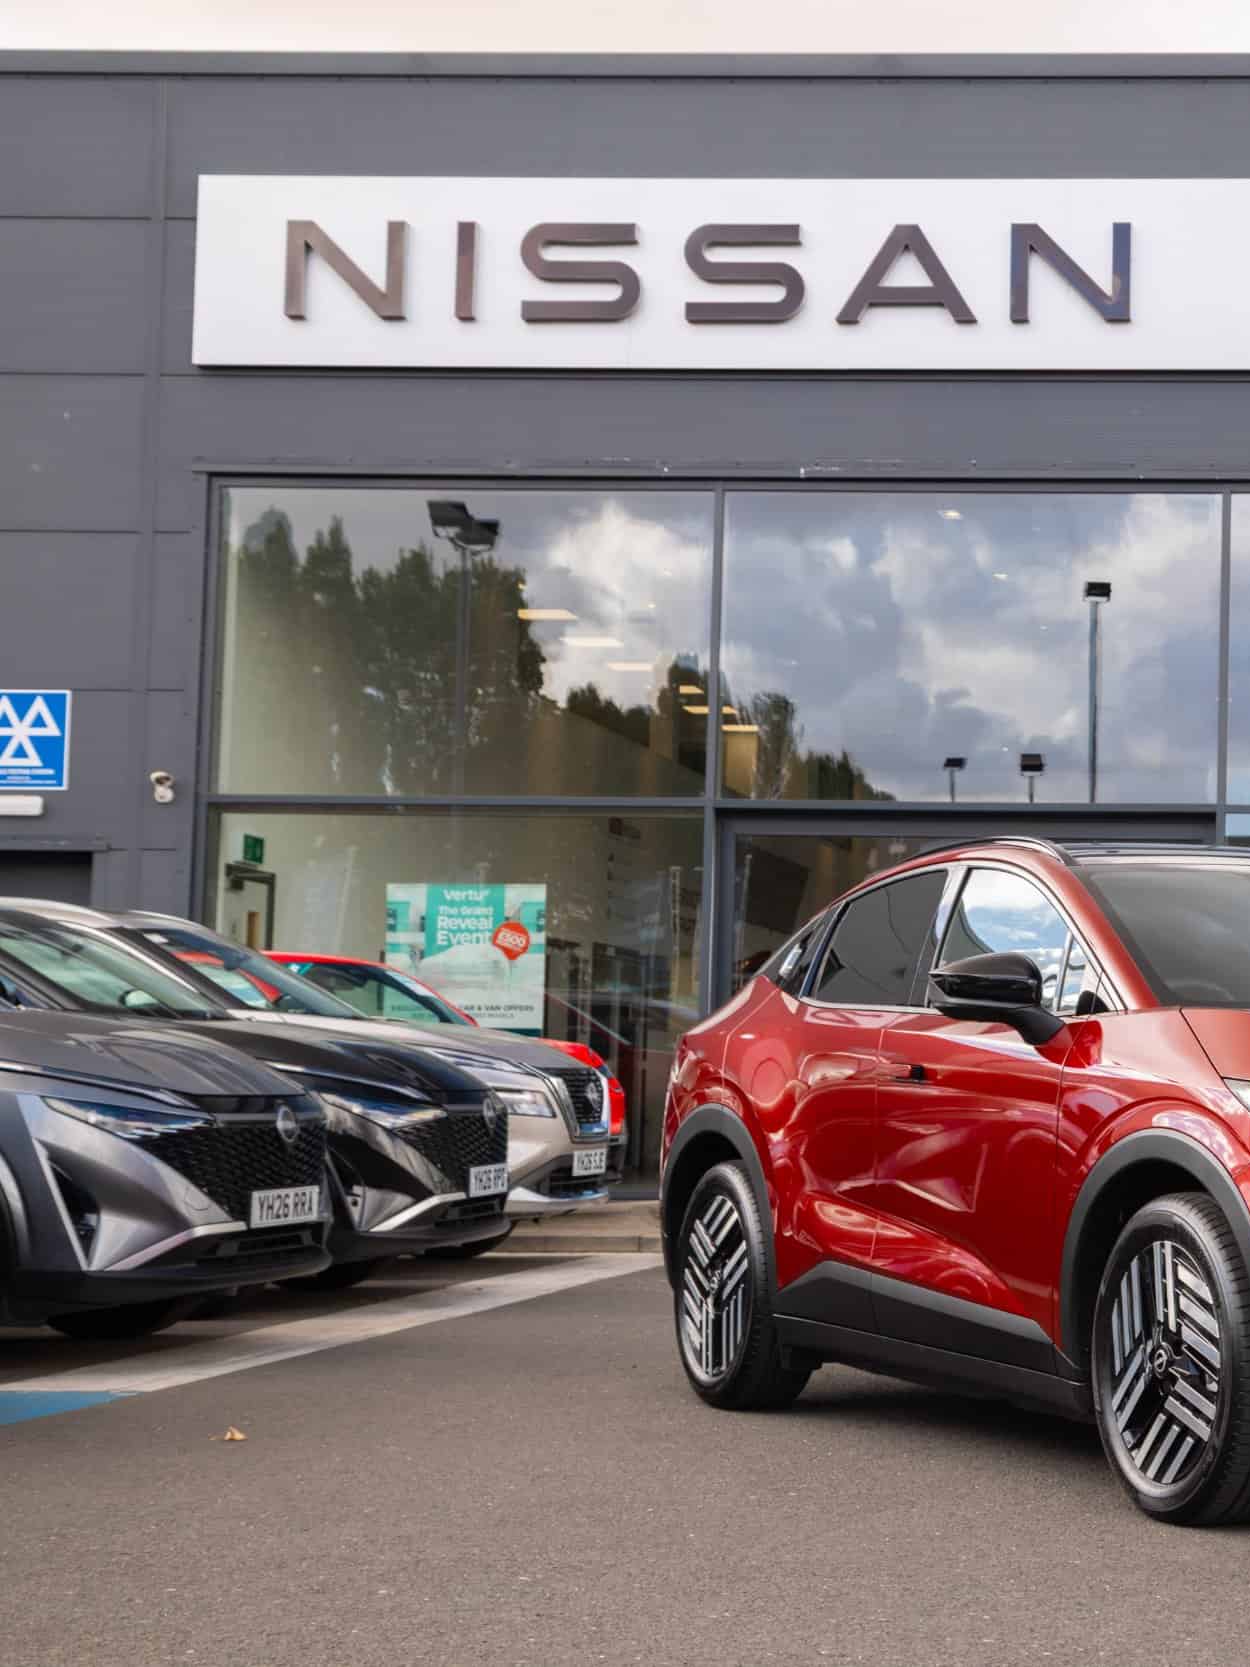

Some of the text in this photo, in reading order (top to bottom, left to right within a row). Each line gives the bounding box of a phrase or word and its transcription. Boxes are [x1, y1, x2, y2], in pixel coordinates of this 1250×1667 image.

[284, 219, 1132, 325] NISSAN
[438, 916, 493, 930] Reveal
[258, 1191, 313, 1221] YH26 RRA
